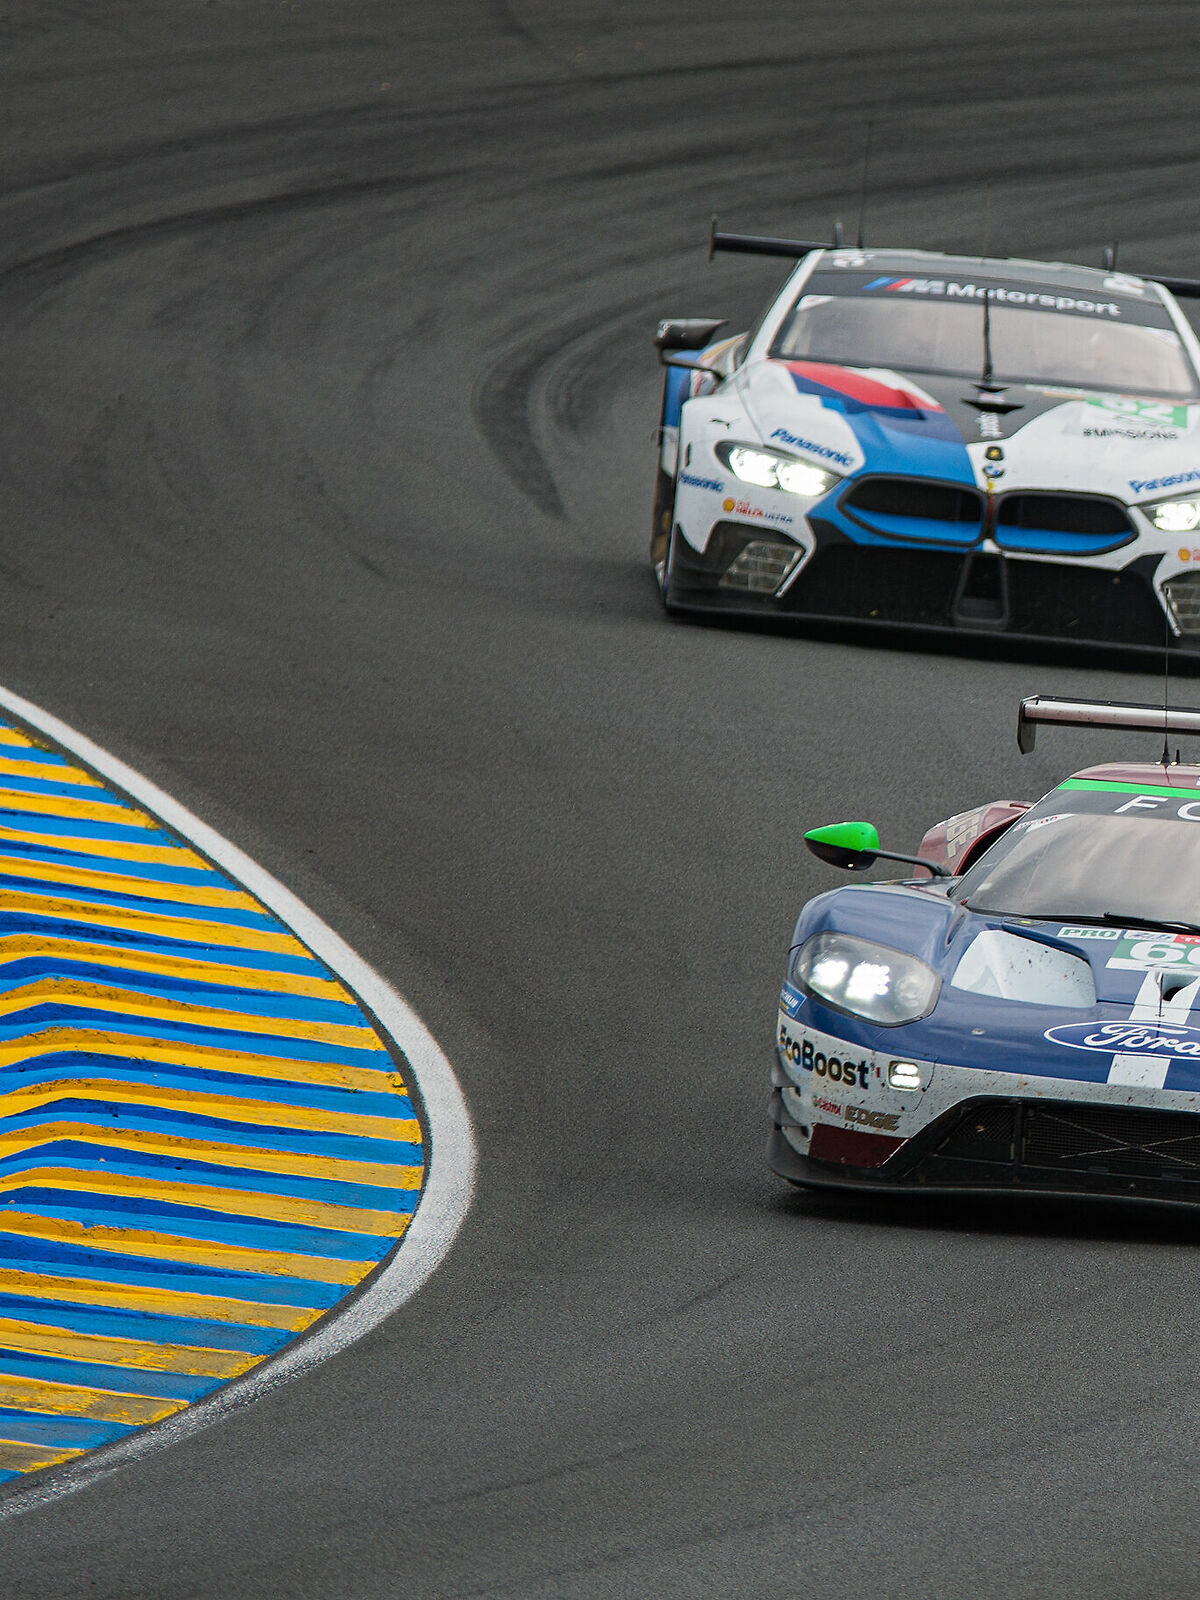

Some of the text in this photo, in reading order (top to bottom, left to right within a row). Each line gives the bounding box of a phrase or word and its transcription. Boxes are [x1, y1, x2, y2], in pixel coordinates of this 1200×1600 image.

[946, 282, 1121, 316] Motorsport
[770, 428, 855, 467] Panasonic
[1062, 926, 1118, 940] PRO
[779, 1024, 869, 1090] EcoBoost
[844, 1104, 902, 1132] EDGE
